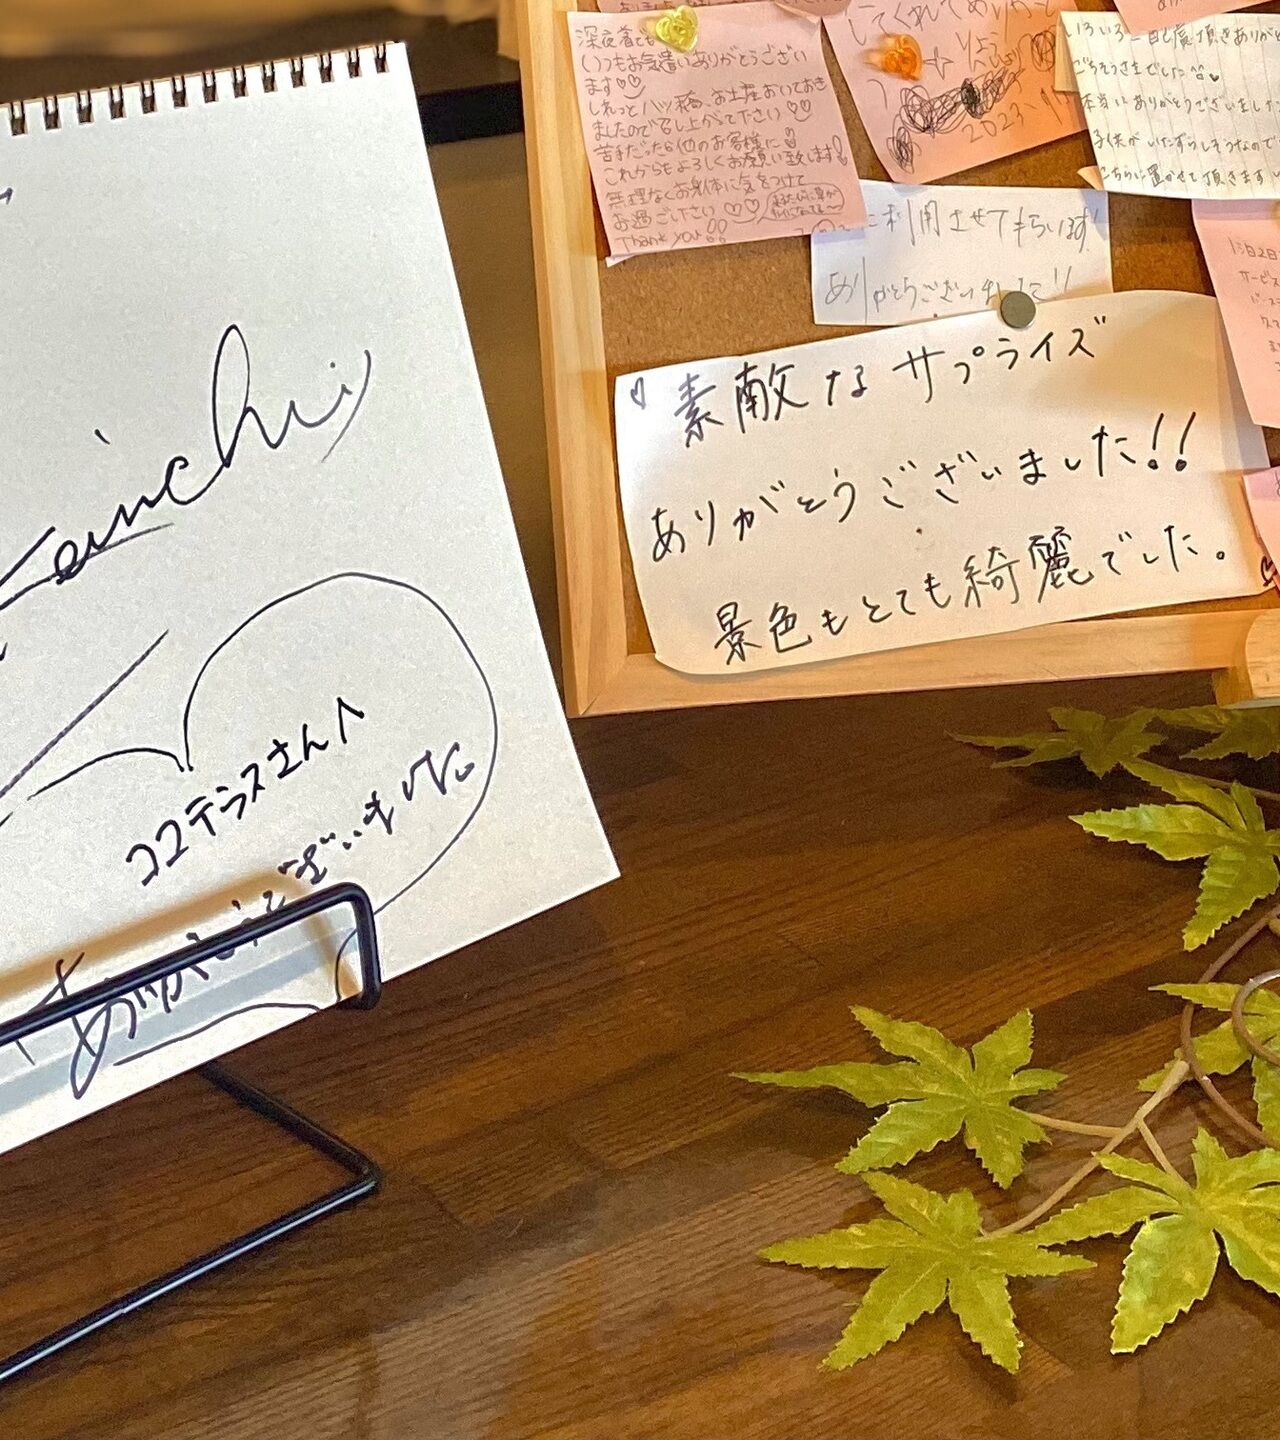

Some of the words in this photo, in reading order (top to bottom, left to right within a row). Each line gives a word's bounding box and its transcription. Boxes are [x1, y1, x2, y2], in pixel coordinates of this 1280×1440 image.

[713, 523, 1228, 666] 景色もとても綺麗でした。
